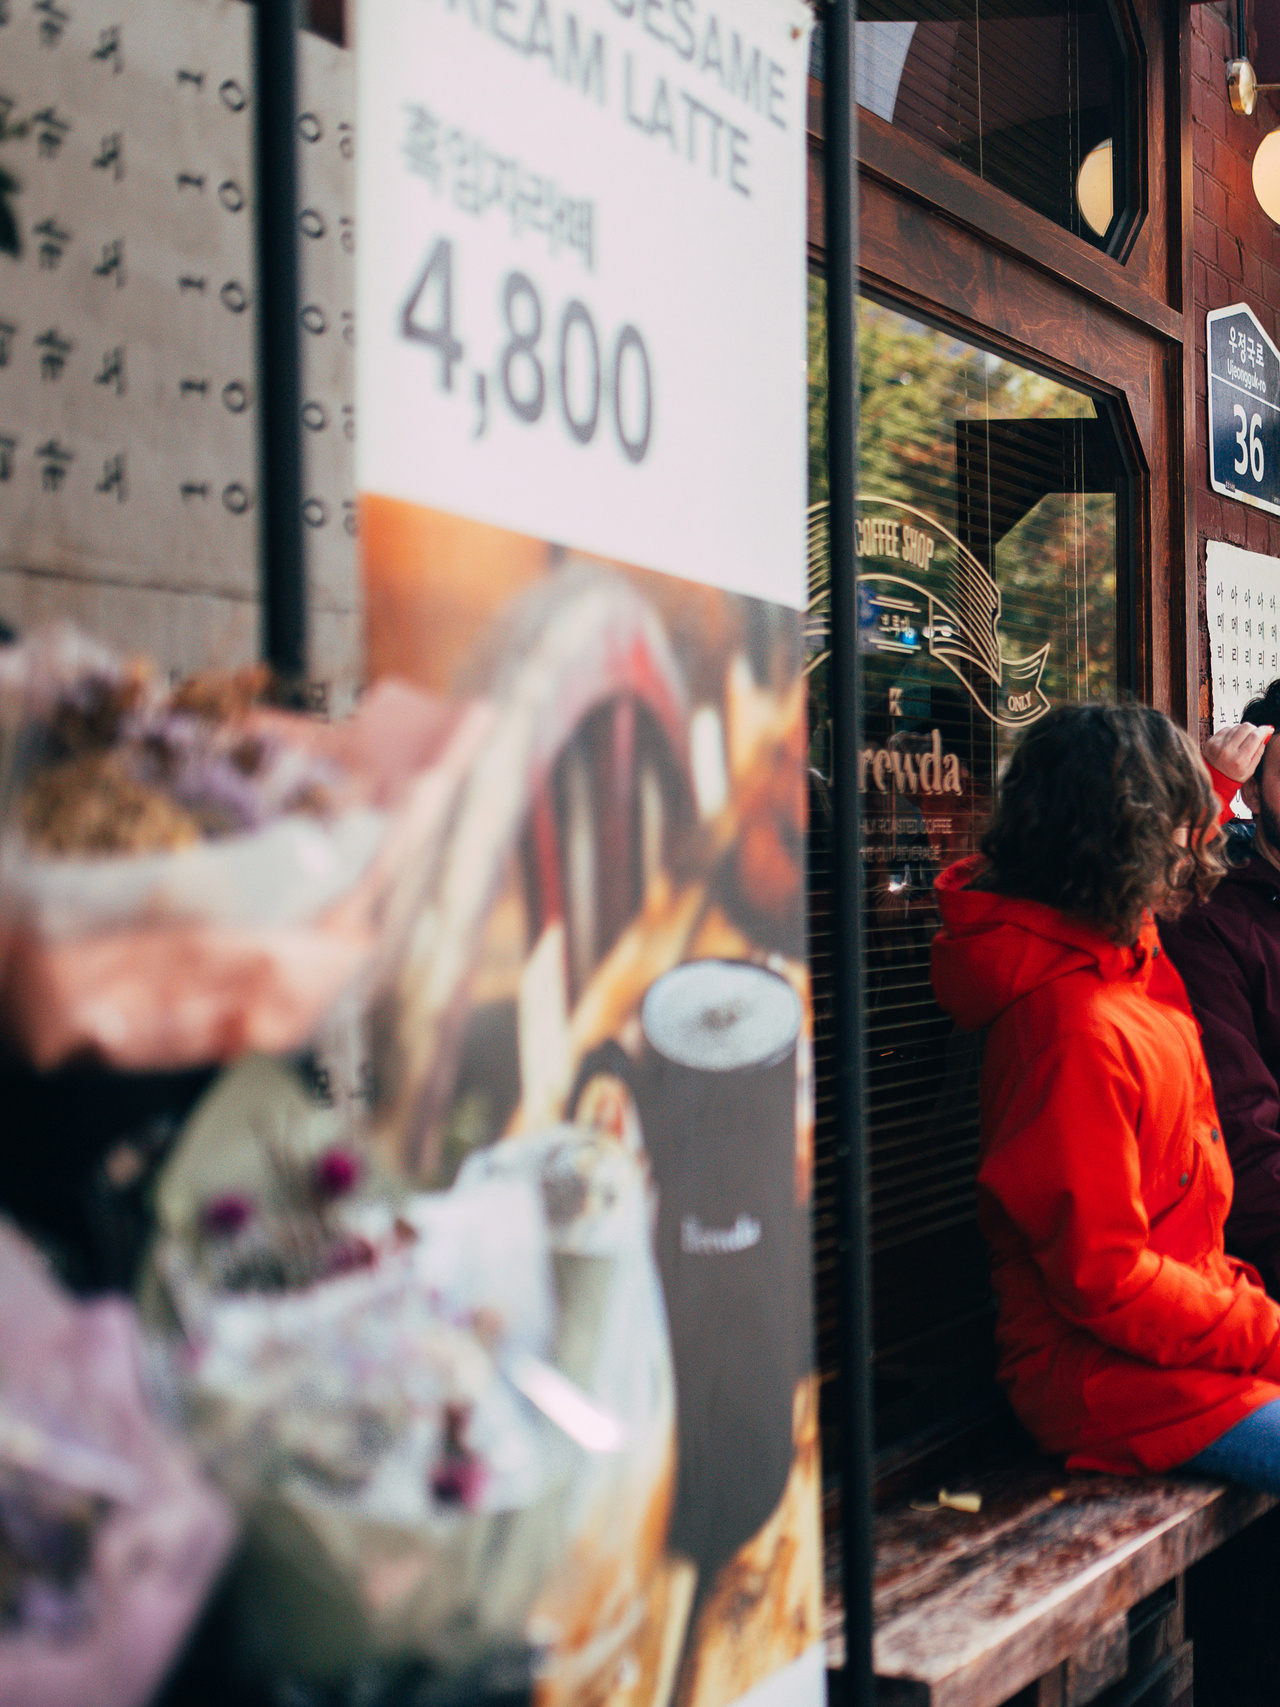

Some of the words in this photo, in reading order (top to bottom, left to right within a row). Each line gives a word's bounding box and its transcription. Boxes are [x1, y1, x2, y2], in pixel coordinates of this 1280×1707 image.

[624, 50, 752, 198] LATTE
[399, 233, 654, 465] 4,800
[1227, 357, 1267, 394] Ujeongguk-ro
[1228, 326, 1265, 368] 우정국로
[1233, 403, 1265, 482] 36
[854, 518, 899, 558] COFFEE
[902, 525, 934, 571] SHOP
[1007, 691, 1032, 713] ONLY
[857, 728, 963, 796] rewda
